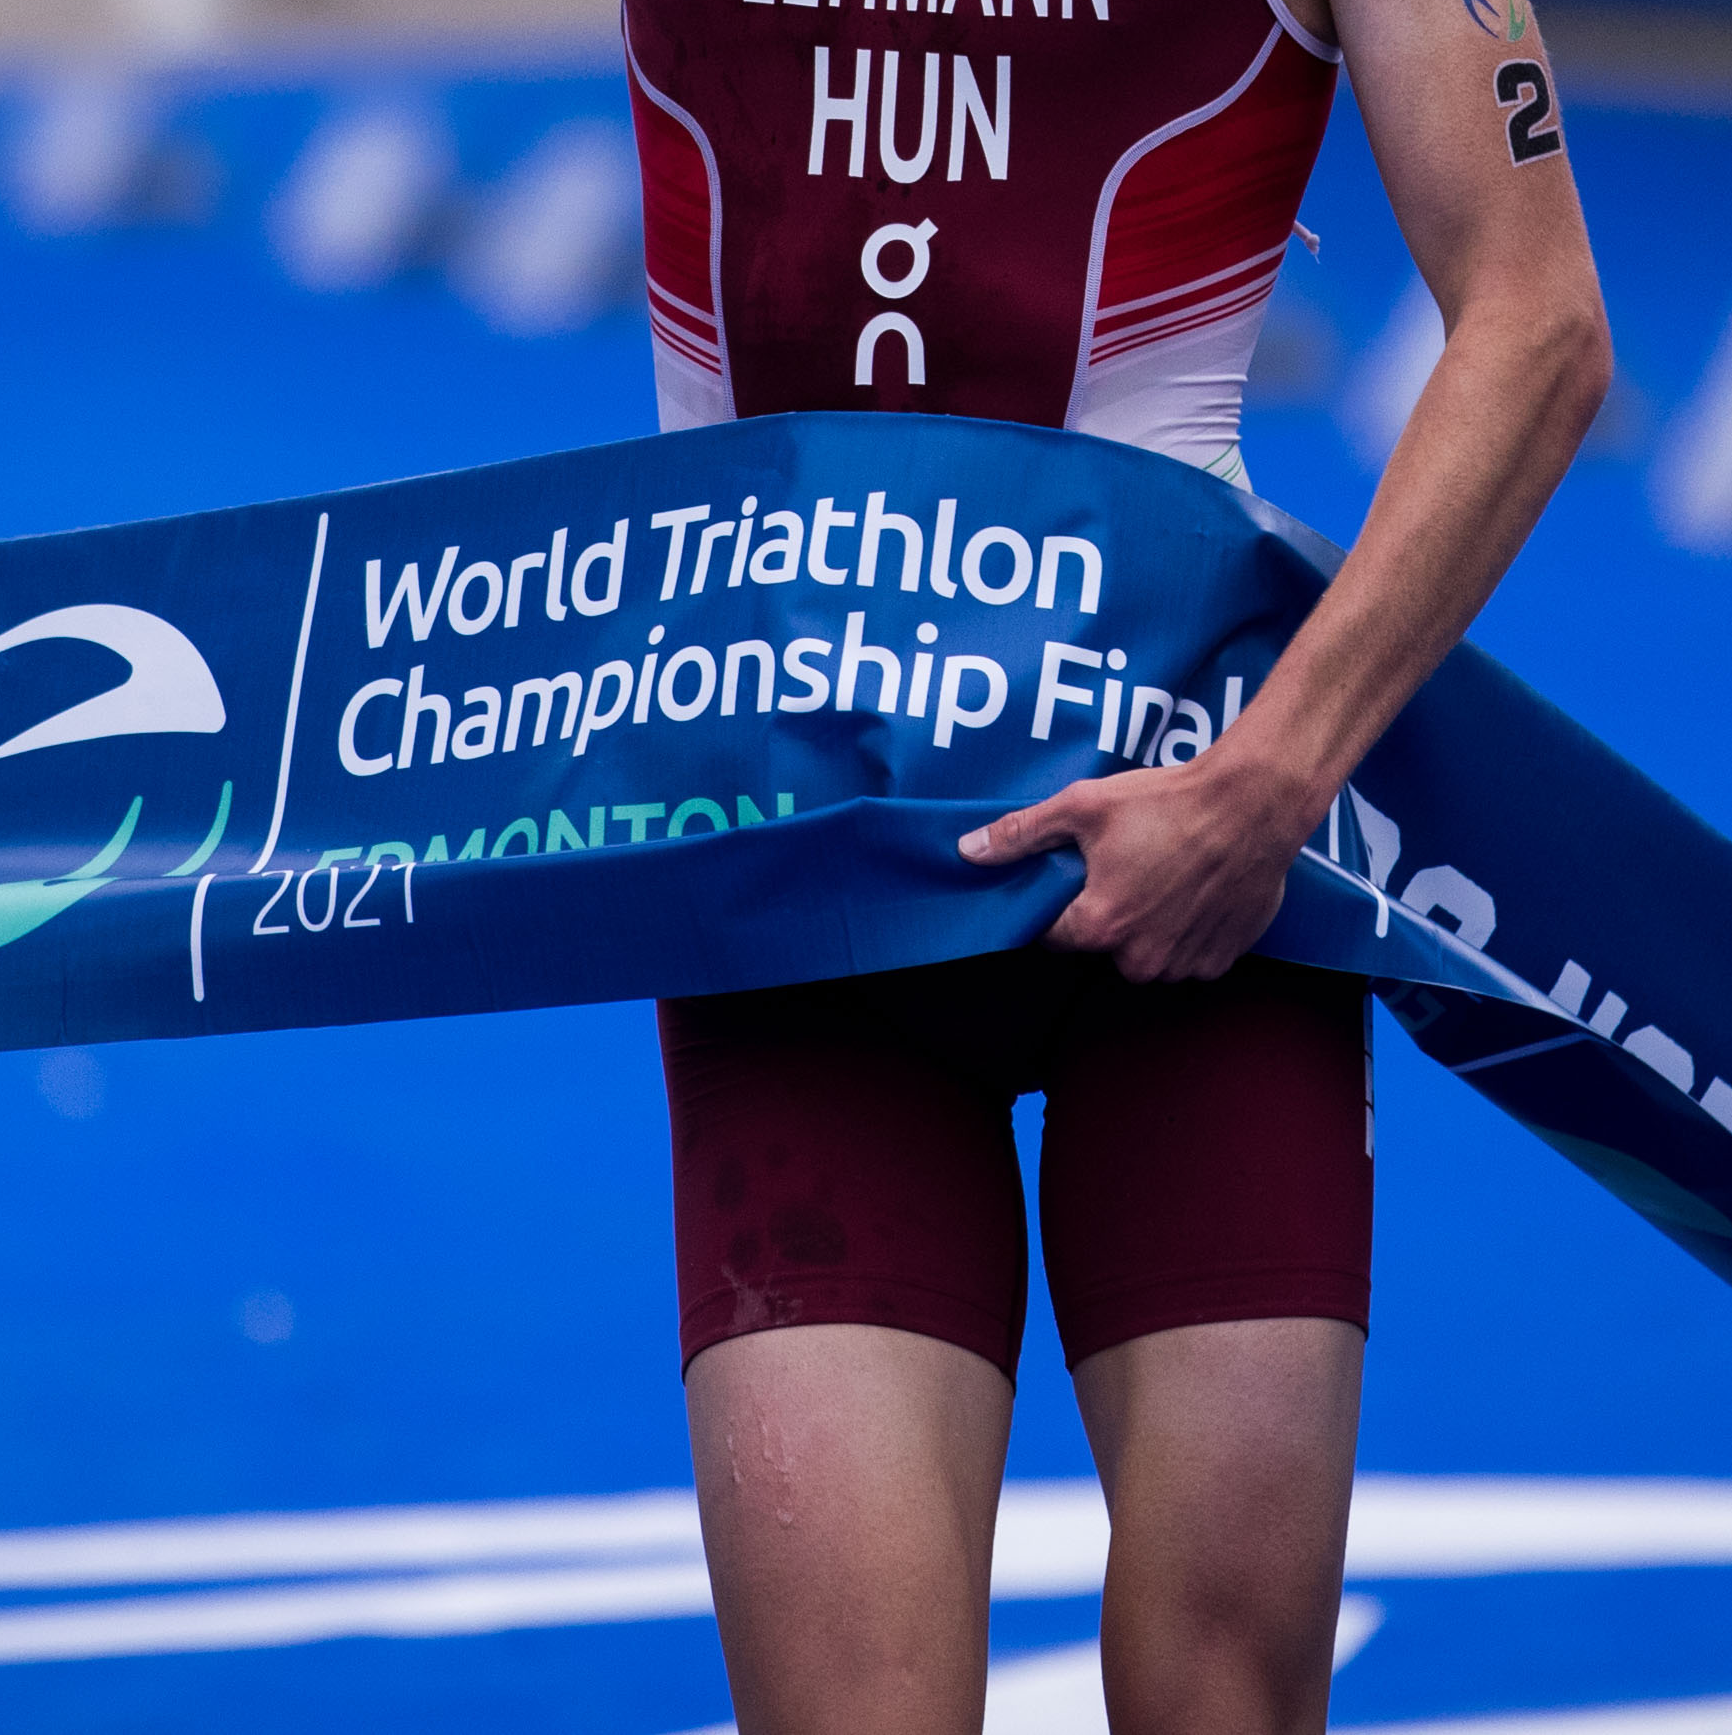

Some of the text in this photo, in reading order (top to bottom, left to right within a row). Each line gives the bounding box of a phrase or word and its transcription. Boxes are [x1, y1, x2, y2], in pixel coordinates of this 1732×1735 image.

[807, 46, 1011, 184] HUN
[1493, 58, 1564, 168] 2
[365, 490, 1103, 649] World Triathlon
[338, 610, 1009, 777] Championship
[252, 862, 417, 936] 2021
